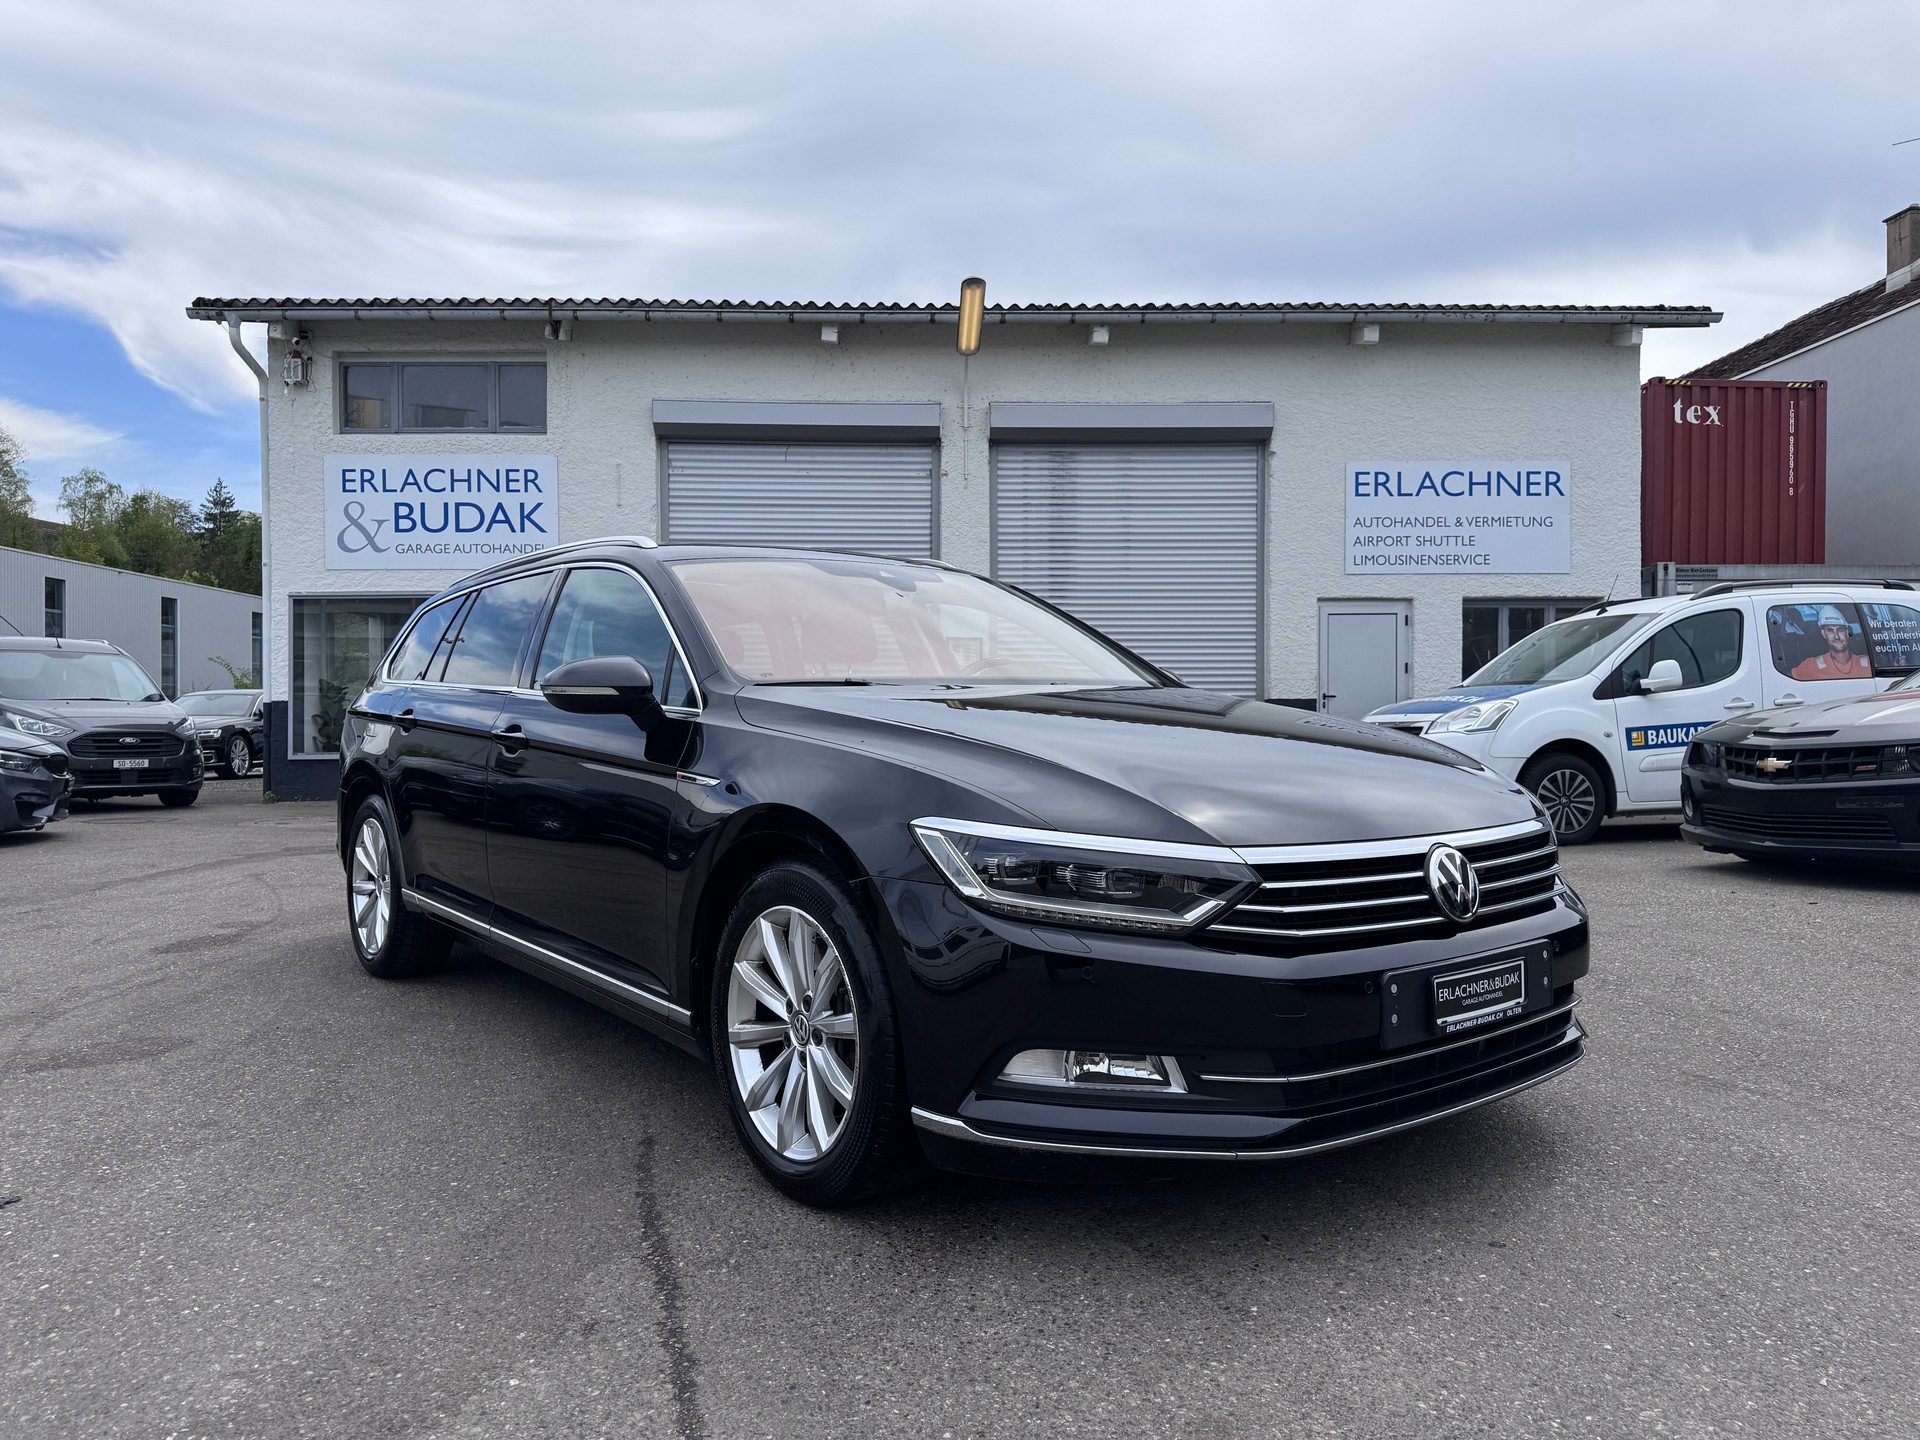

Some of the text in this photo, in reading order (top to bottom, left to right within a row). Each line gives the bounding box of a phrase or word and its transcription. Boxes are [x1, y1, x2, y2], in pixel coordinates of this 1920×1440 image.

[341, 469, 543, 493] ERLACHNER
[1354, 471, 1566, 497] ERLACHNER
[1788, 487, 1794, 496] 8
[336, 500, 548, 554] & BUDAK
[1353, 516, 1554, 528] AUTOHANDEL & VERMIETUNG
[1353, 535, 1476, 547] AIRPORT SHUTTLE
[395, 543, 450, 554] GARAGE
[1353, 554, 1491, 566] LIMOUSINENSERVICE
[1868, 619, 1917, 628] Wir beraten
[1872, 631, 1889, 640] und
[1875, 644, 1897, 653] euch
[1898, 643, 1910, 652] im
[1506, 1006, 1522, 1017] OLTEN
